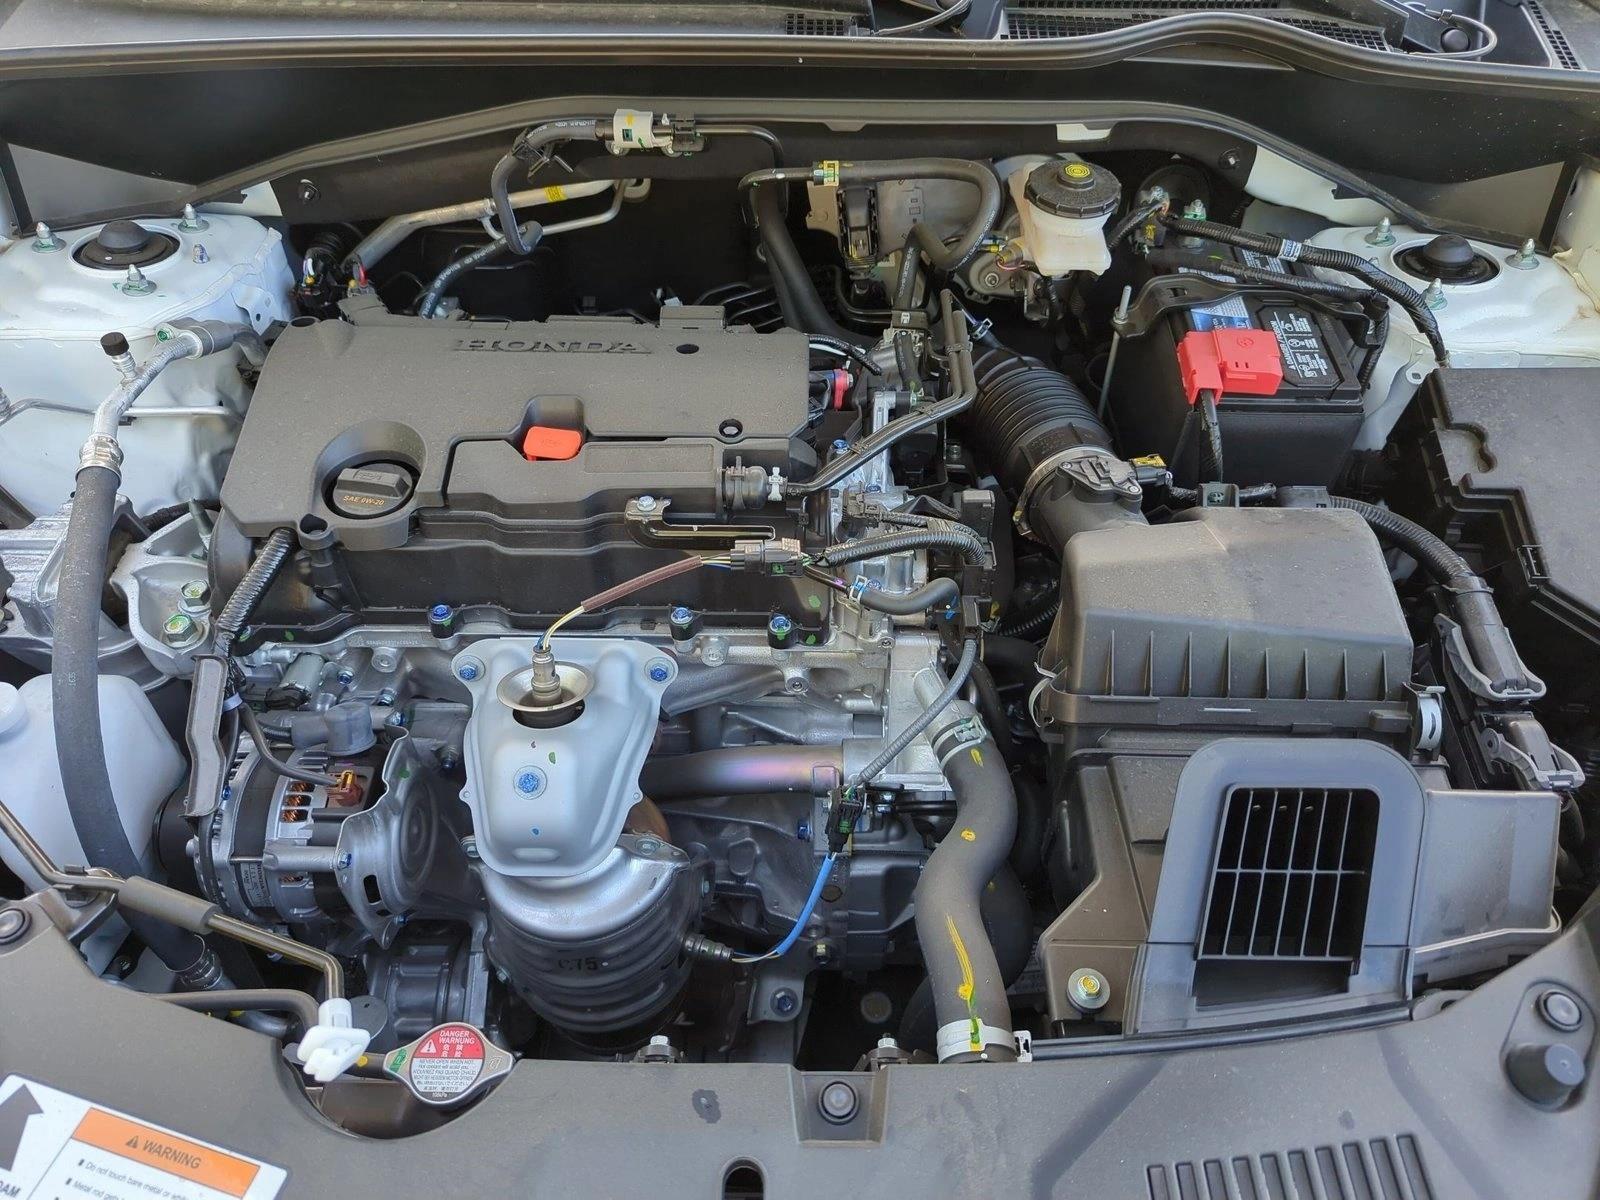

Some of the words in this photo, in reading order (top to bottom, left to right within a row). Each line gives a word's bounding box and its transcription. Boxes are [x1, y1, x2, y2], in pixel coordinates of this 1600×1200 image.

[453, 337, 653, 355] HONDA
[343, 495, 360, 503] SAE
[361, 497, 385, 506] 0W-20
[142, 1139, 202, 1170] WARNING
[85, 1161, 96, 1172] Do
[96, 1165, 108, 1176] not
[109, 1168, 127, 1182] touch
[126, 1175, 143, 1188] bare
